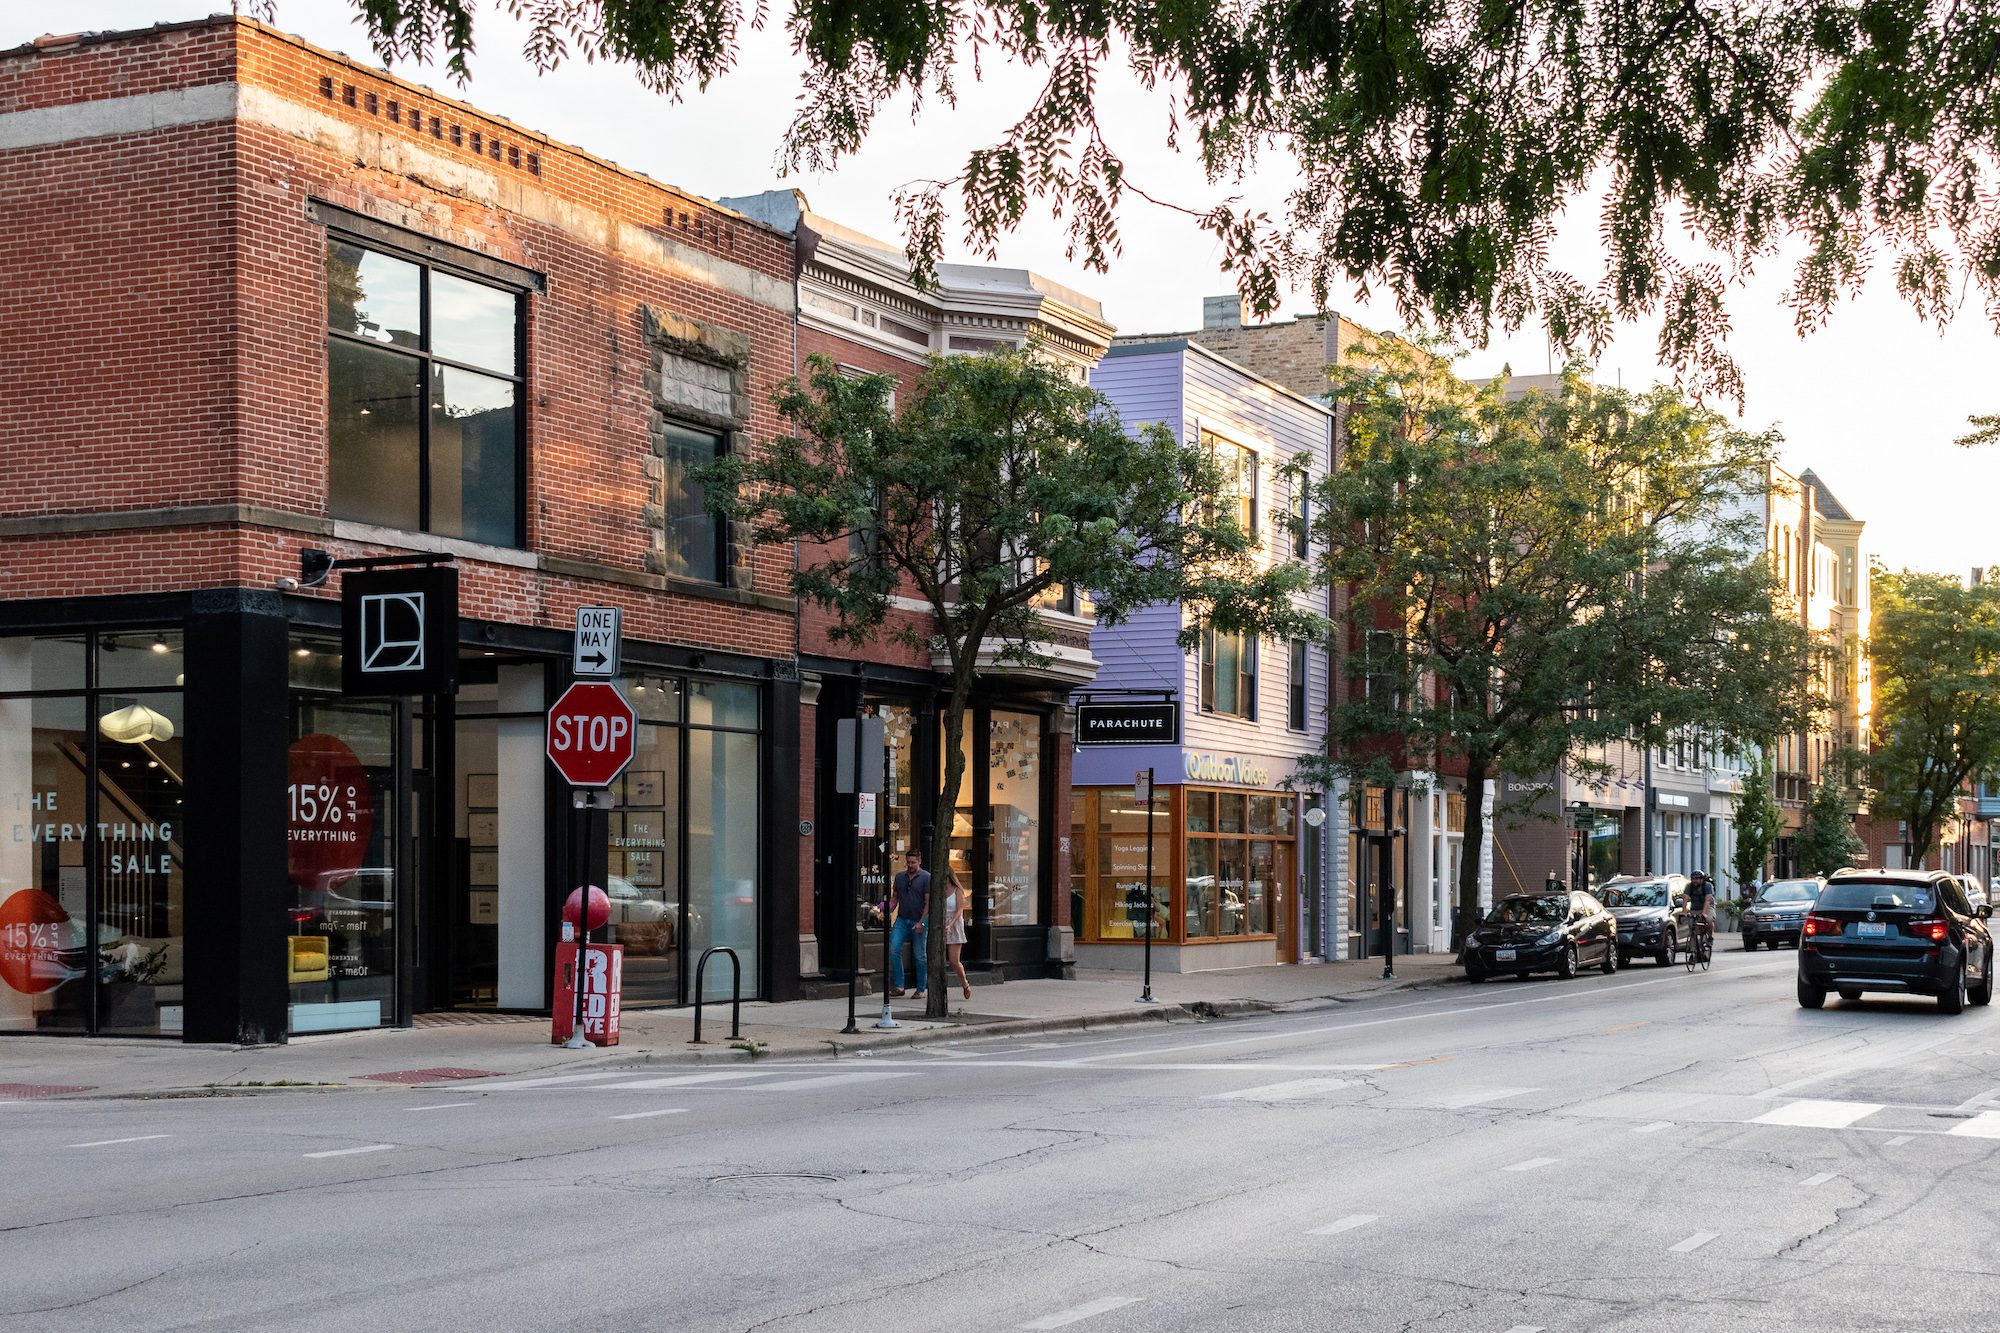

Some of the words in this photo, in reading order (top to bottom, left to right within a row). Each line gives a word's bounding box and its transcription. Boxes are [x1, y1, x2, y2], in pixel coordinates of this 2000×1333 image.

[582, 613, 611, 628] ONE
[581, 631, 611, 647] WAY
[1090, 719, 1163, 728] PARACHUTE
[553, 714, 628, 753] STOP
[1189, 751, 1236, 782] Outdoor
[1234, 756, 1269, 785] Voices
[13, 791, 58, 811] THE
[288, 784, 342, 823] 15%
[347, 786, 356, 823] OFF
[13, 822, 173, 843] EVERYTHING
[633, 824, 649, 833] THE
[615, 838, 666, 847] EVERYTHING
[111, 855, 172, 874] SALE
[631, 852, 651, 861] SALE
[5, 923, 47, 948] 15%
